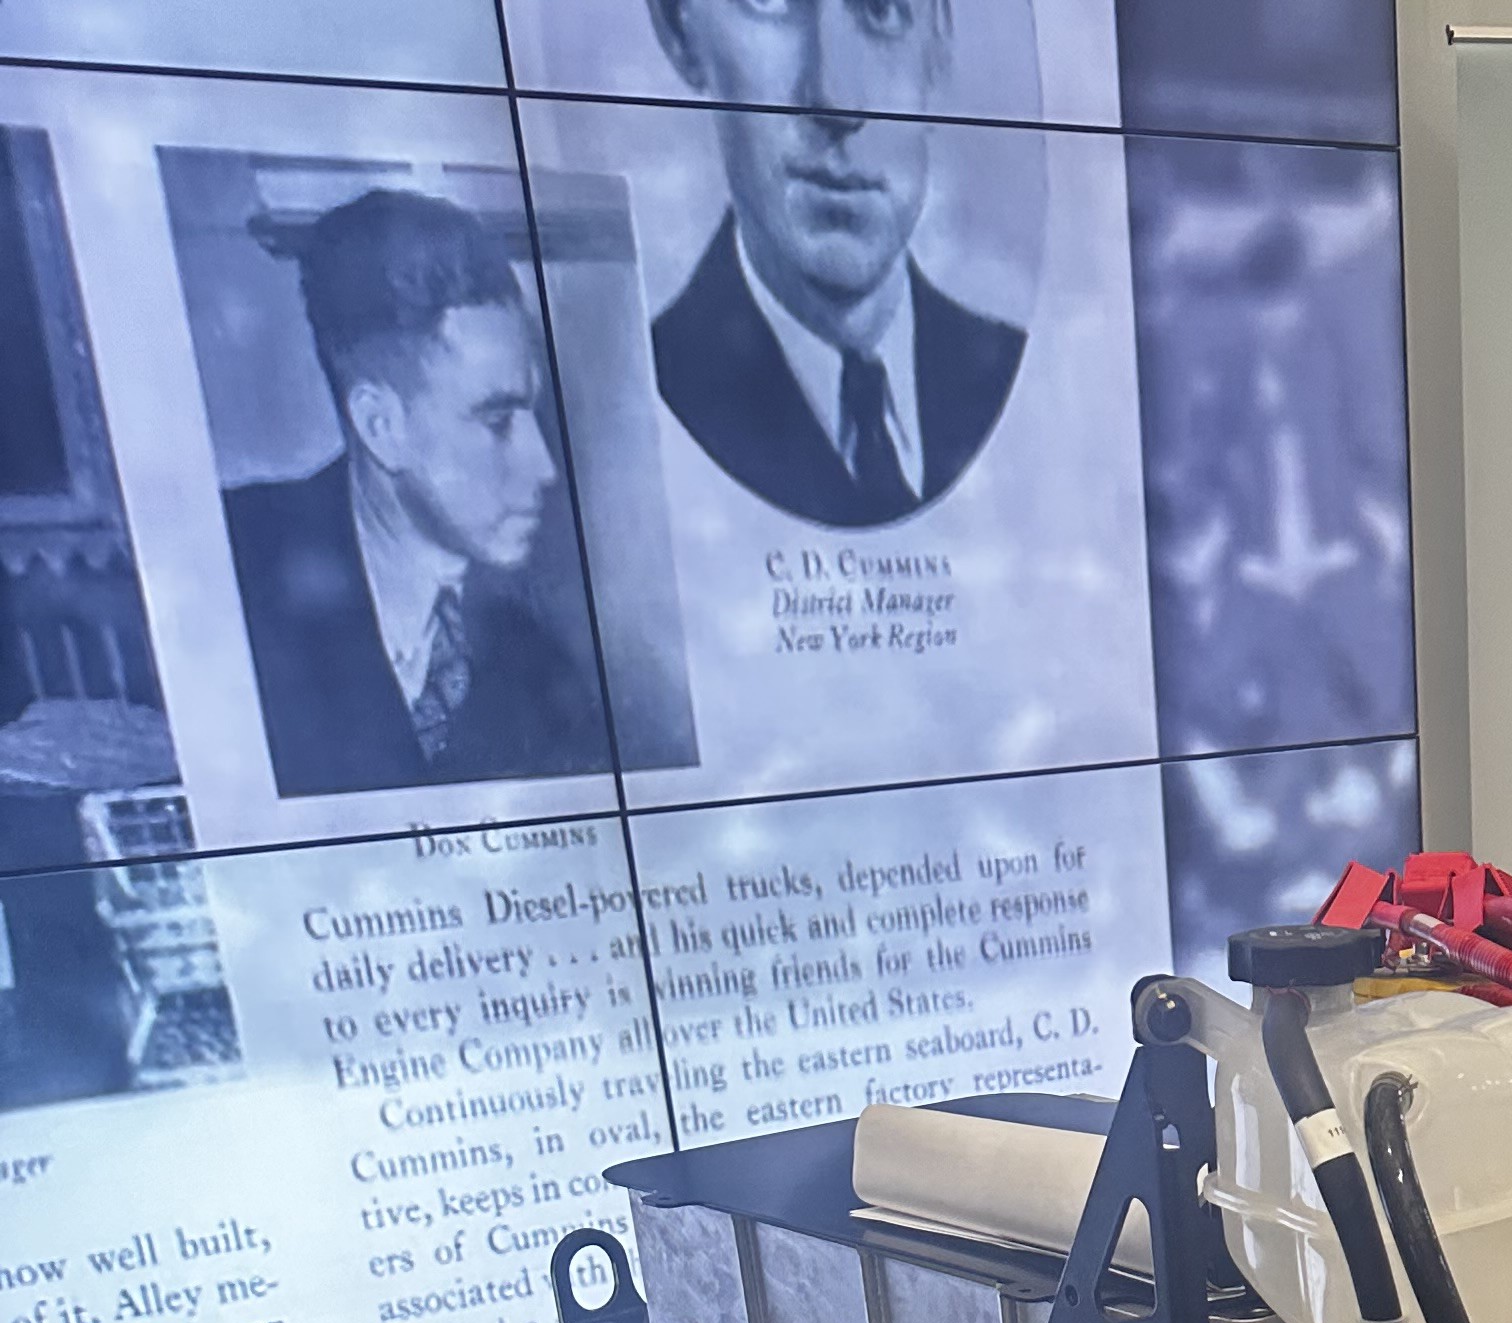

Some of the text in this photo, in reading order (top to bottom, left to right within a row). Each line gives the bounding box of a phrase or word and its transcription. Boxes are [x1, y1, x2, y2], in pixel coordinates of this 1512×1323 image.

[772, 587, 957, 619] District Manager
[775, 622, 958, 655] New York Region
[303, 898, 463, 940] Cummins
[726, 864, 823, 900] trucks,
[838, 850, 962, 896] depended
[978, 850, 1038, 884] upon
[1054, 837, 1086, 873] for
[313, 953, 394, 993] daily
[408, 943, 533, 982] delivery
[672, 919, 713, 957] his
[721, 907, 799, 955] quick
[808, 904, 856, 940] and
[867, 894, 982, 935] complete
[991, 886, 1090, 924] response
[324, 923, 1092, 1043] to every inquiry is friends for the Cummins
[333, 986, 973, 1092] Engine Company all over the United States.
[379, 1005, 1099, 1129] Continuously travling the eastern seaboard, C. D.
[350, 1058, 1103, 1183] Cummins, in oval, the eastern factory representa-
[361, 1171, 561, 1231] tive, keeps in
[88, 1233, 158, 1273] well
[175, 1219, 272, 1261] built,
[368, 1229, 466, 1278] ers of
[114, 1281, 203, 1321] Alley
[217, 1275, 280, 1303] me-
[378, 1266, 535, 1322] associated
